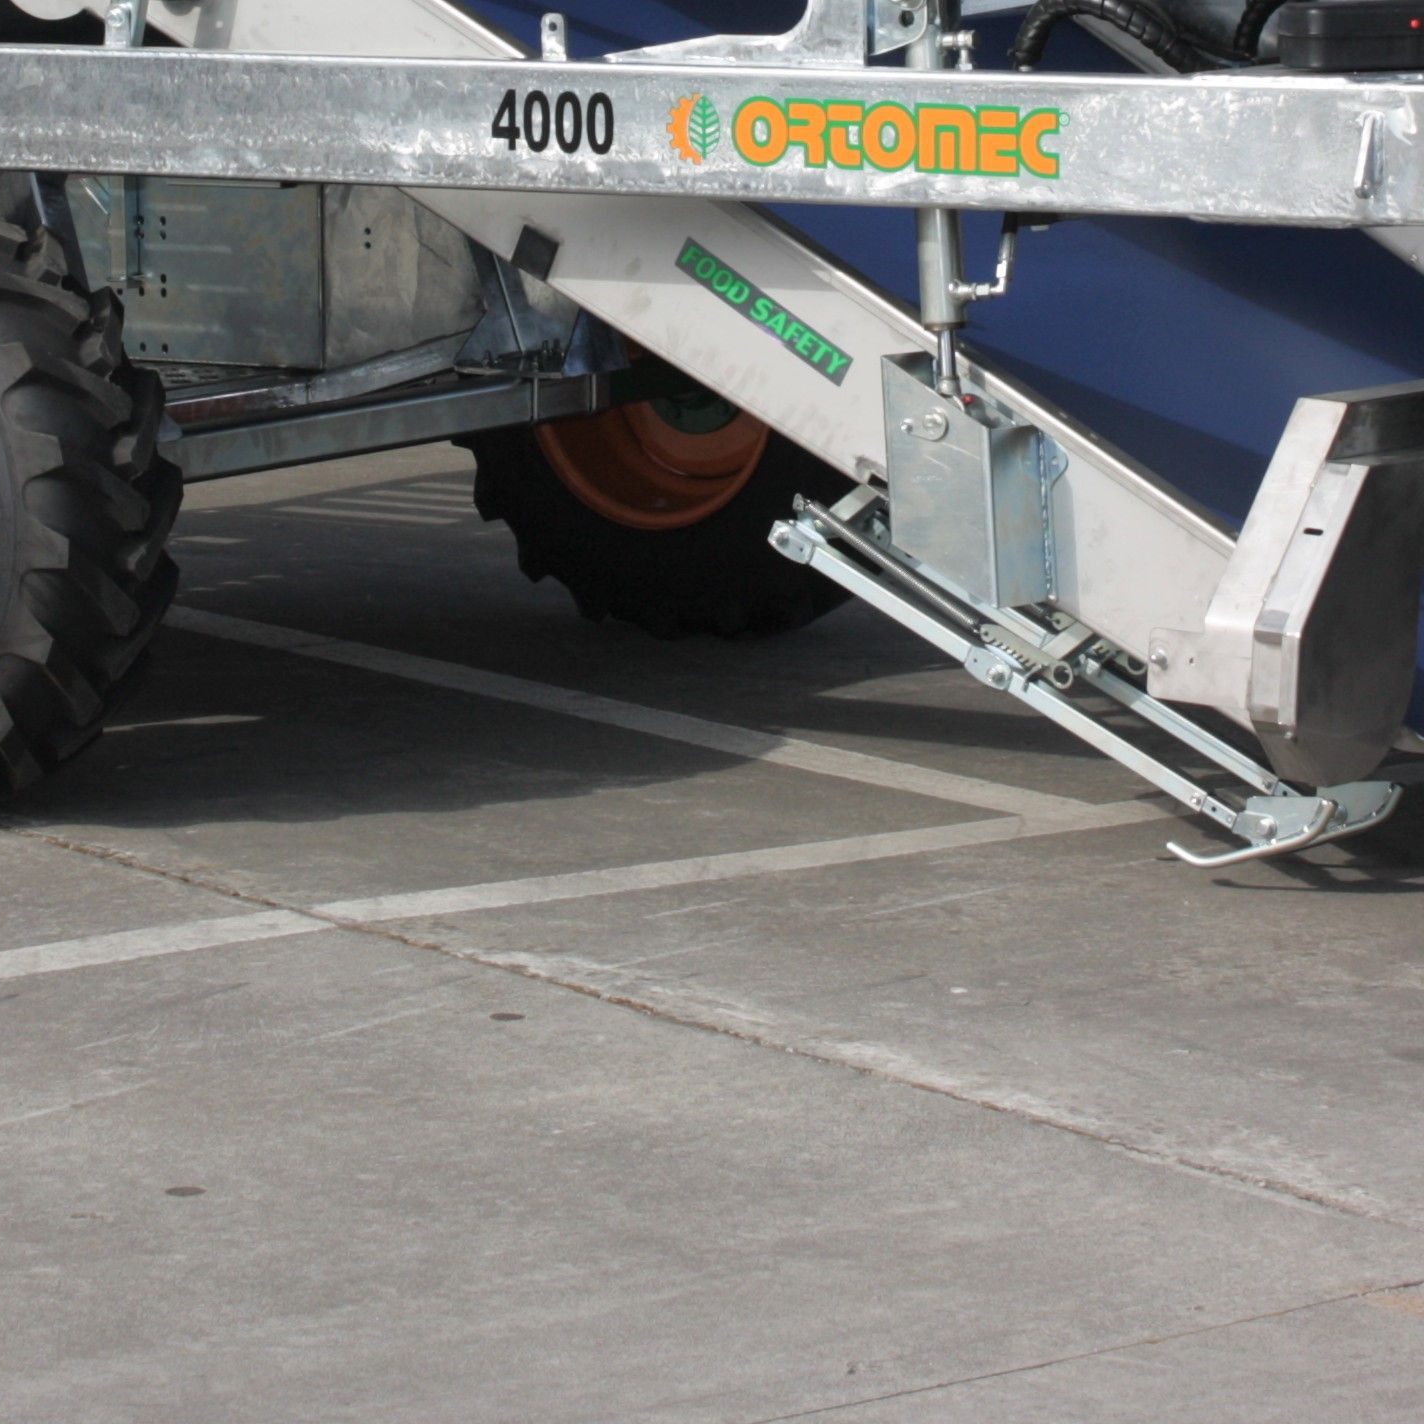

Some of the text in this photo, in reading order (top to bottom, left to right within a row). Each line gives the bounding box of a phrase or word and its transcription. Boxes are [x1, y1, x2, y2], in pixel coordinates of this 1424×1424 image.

[491, 89, 1061, 179] 4000 ORTOMEC
[680, 243, 848, 376] FOOD SAFETY
